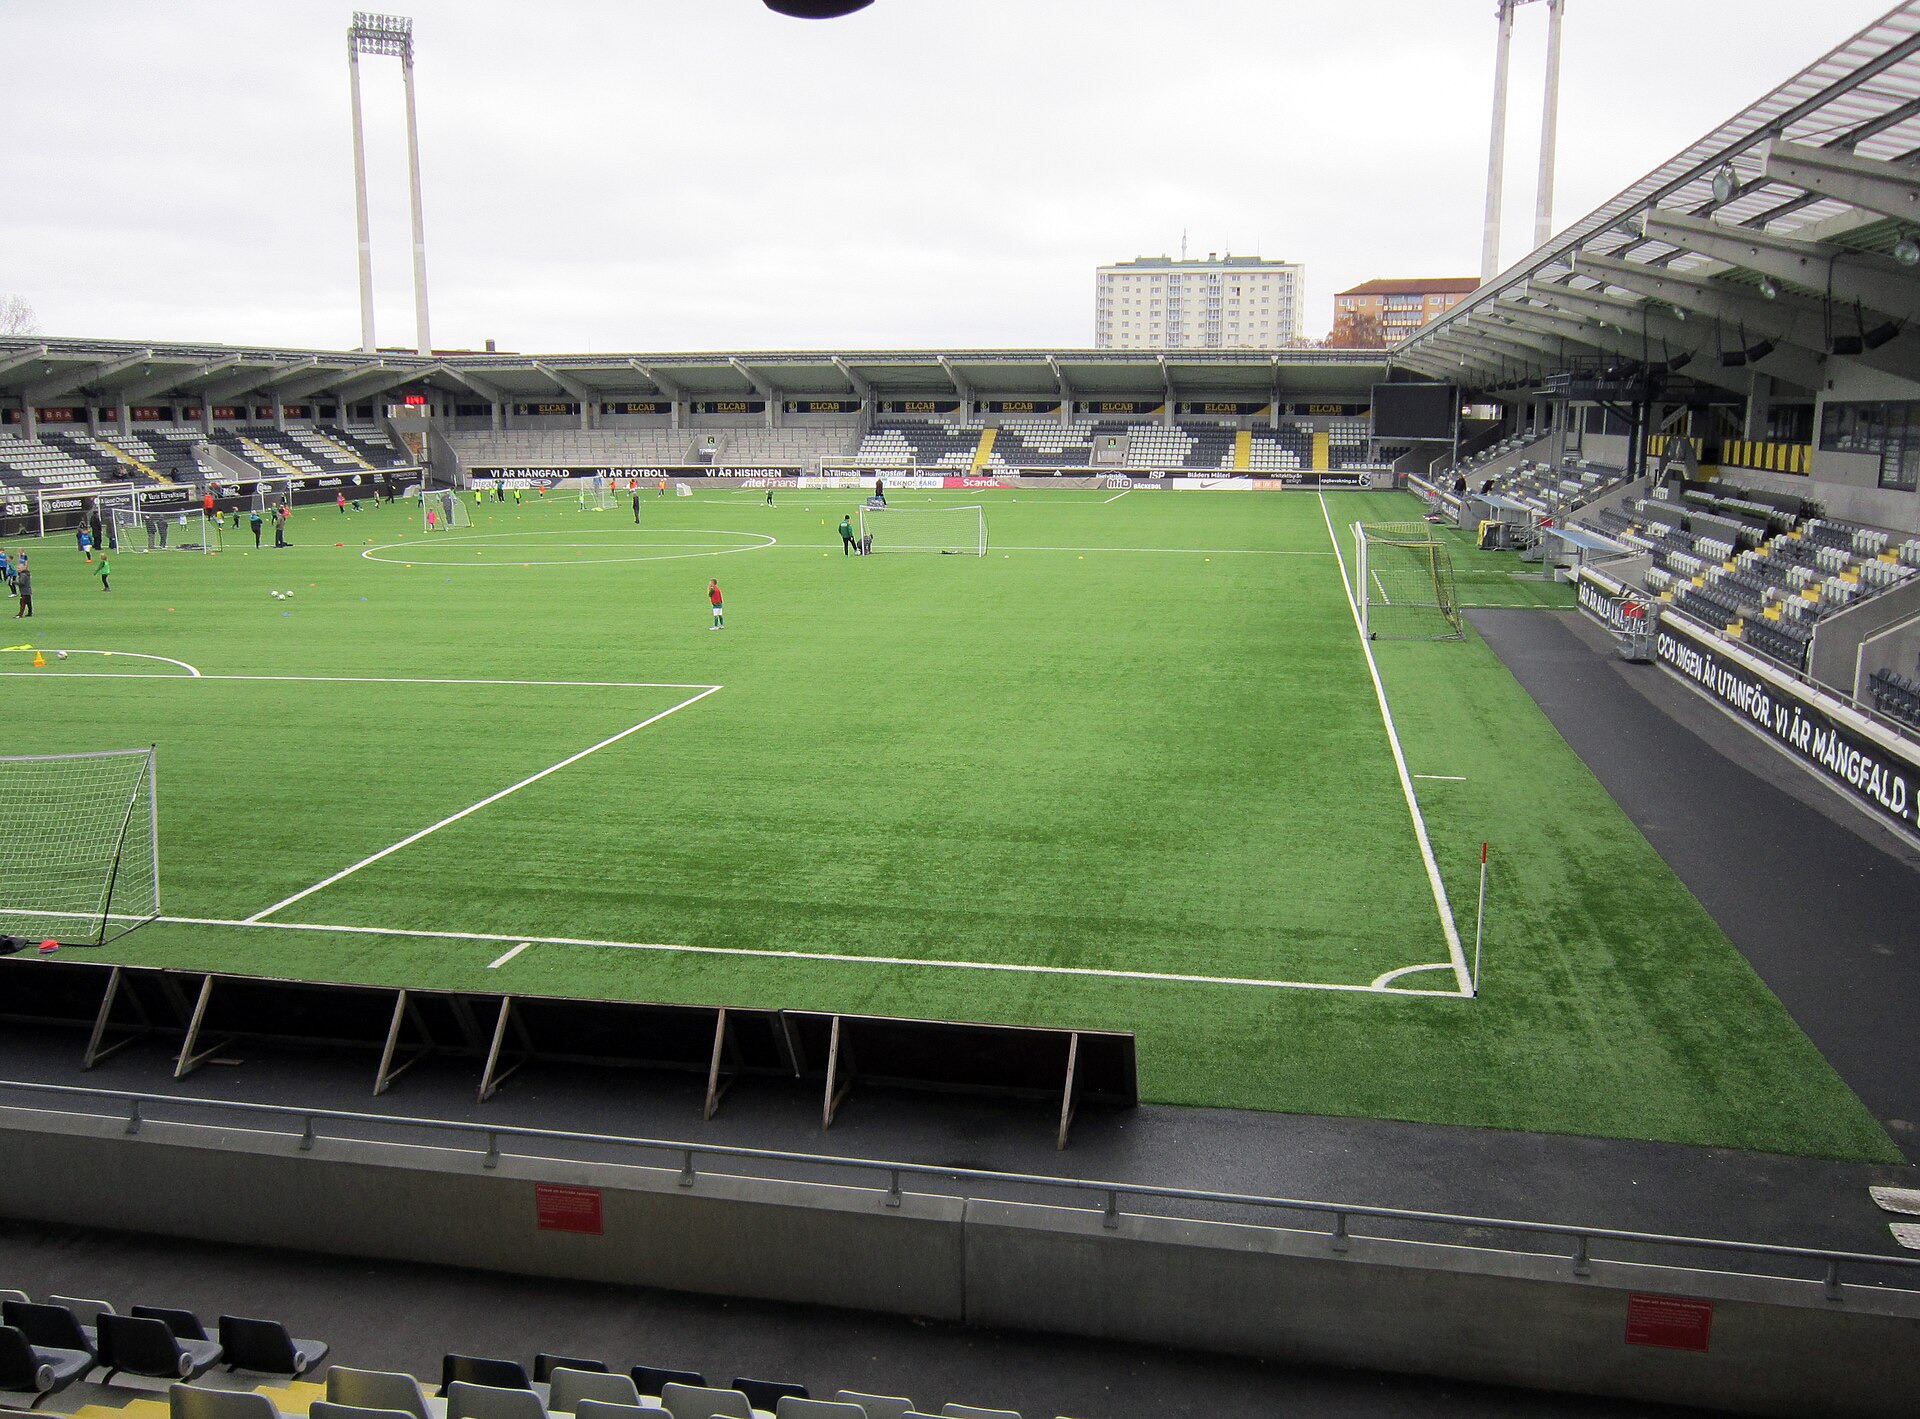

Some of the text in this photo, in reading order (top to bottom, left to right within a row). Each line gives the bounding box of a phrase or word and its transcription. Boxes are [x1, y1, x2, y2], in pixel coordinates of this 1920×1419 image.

[627, 403, 655, 411] ELCAB
[717, 402, 746, 411] ELCAB
[810, 402, 840, 411] ELCAB
[905, 402, 936, 411] ELCAB
[1002, 402, 1033, 411] ELCAB
[1102, 403, 1134, 411] ELCAB
[1204, 403, 1237, 412] ELCAB
[1309, 404, 1342, 413] ELCAB
[490, 467, 570, 477] VI ÄR MÅNGFALD
[597, 468, 669, 477] VI ÄR FOTBOLL
[705, 467, 782, 477] VI ÄR HISINGEN
[1148, 471, 1166, 480] ISP
[767, 478, 797, 487] Finans
[963, 478, 1000, 487] Scandic
[52, 499, 82, 509] GÖTEBORG
[6, 503, 29, 516] SEB
[1657, 632, 1677, 663] OCH
[1676, 643, 1703, 682] INGEN
[1703, 655, 1717, 691] ÄR
[1717, 674, 1771, 728] UTANFÖR.
[1775, 703, 1790, 738] VI
[1789, 706, 1811, 753] ÄR
[1812, 727, 1909, 819] MÅNGFALD.
